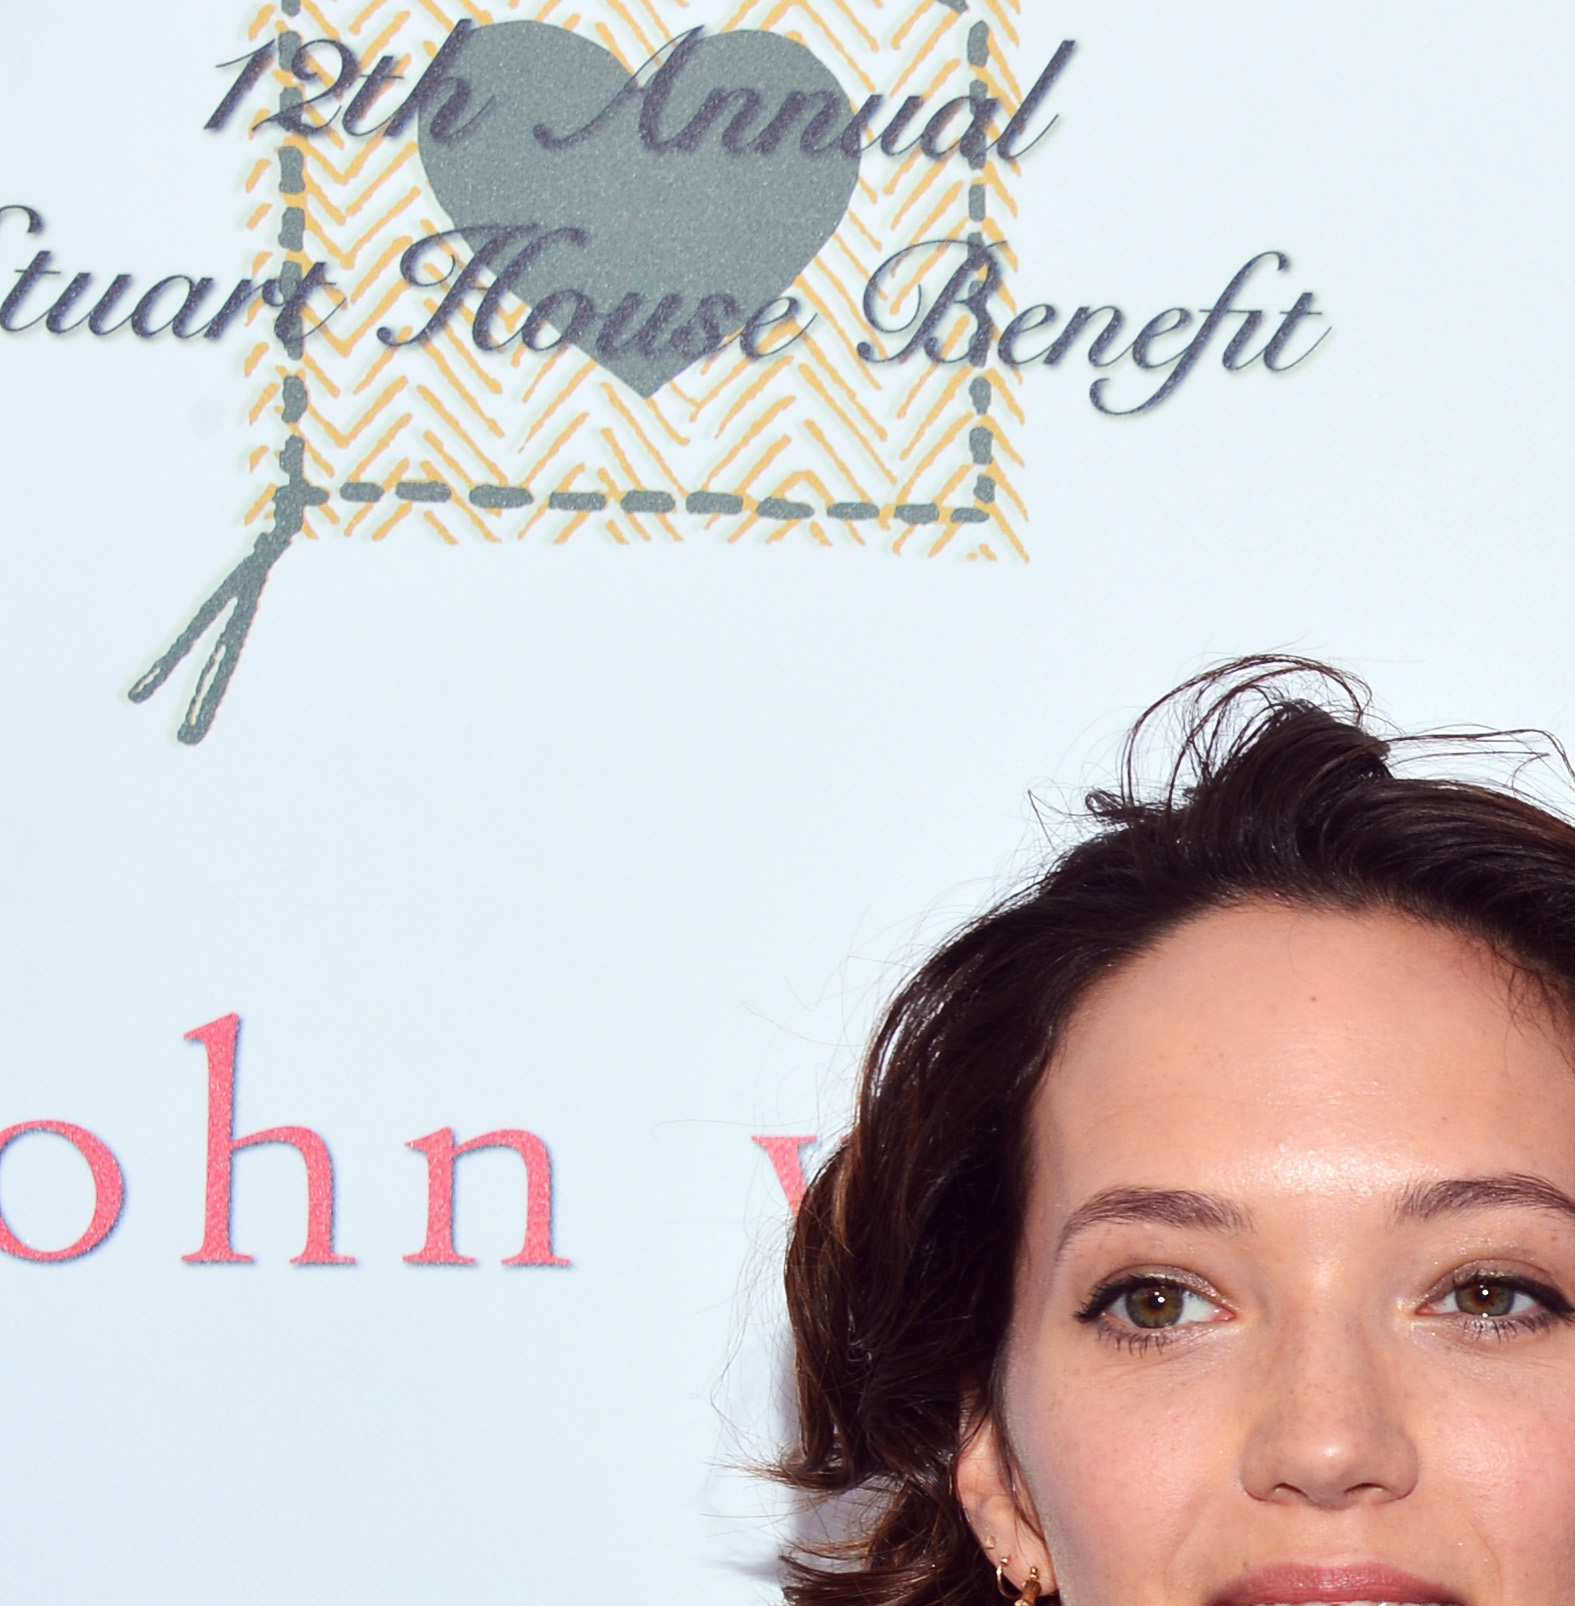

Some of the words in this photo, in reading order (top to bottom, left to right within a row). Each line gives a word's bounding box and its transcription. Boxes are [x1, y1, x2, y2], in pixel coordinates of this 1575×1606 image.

[204, 18, 496, 148] 12th
[531, 25, 1077, 161] Annual
[375, 224, 819, 362] House
[856, 239, 1333, 416] Benefit
